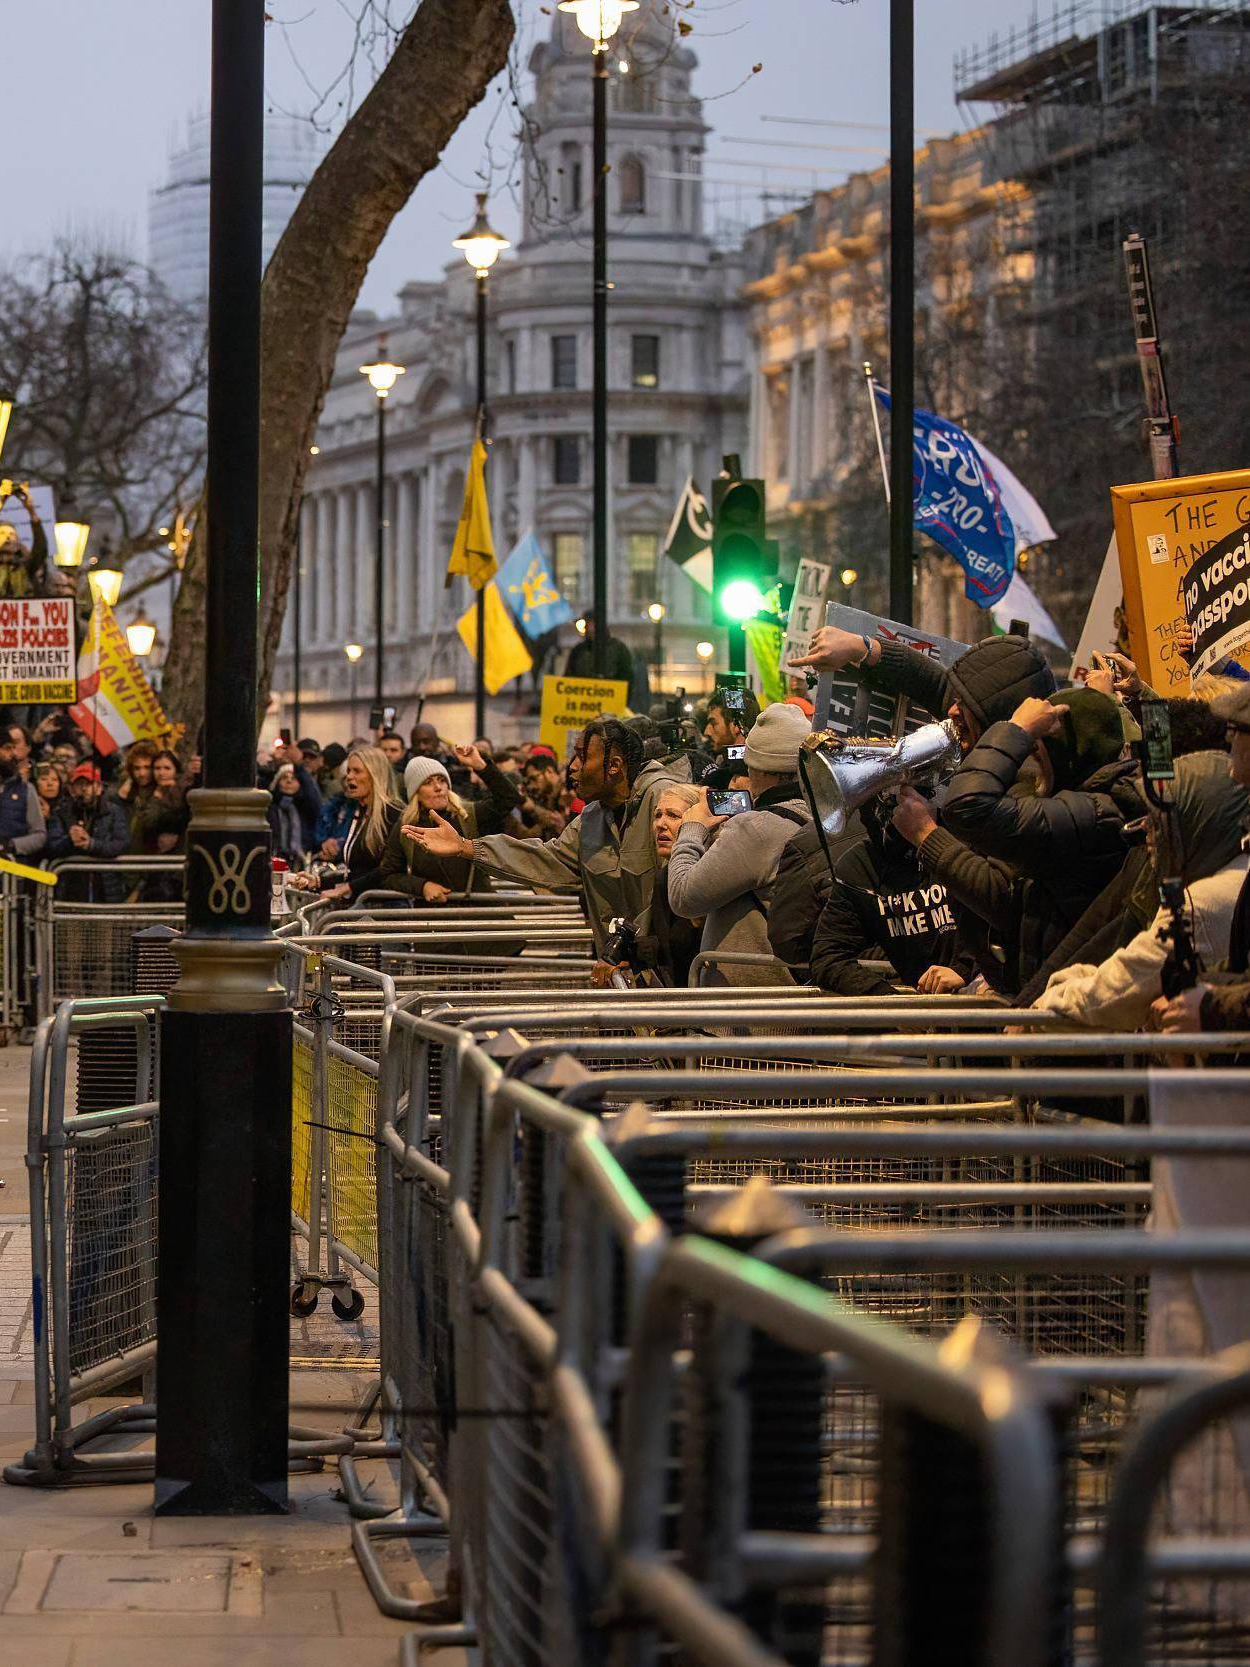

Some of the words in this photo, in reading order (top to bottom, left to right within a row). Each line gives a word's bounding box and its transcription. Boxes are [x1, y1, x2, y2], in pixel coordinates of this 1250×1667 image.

[1165, 500, 1218, 532] THE
[964, 548, 1005, 582] REAT!
[1186, 581, 1199, 615] no
[42, 601, 68, 626] YOU
[21, 627, 68, 648] POLICIES
[12, 665, 70, 679] HUMANITY
[5, 684, 18, 700] THE
[20, 684, 41, 700] COVID
[42, 683, 73, 700] VACCINE
[556, 681, 615, 698] Coercion
[566, 697, 577, 711] is
[580, 701, 602, 712] not
[931, 904, 956, 929] ME
